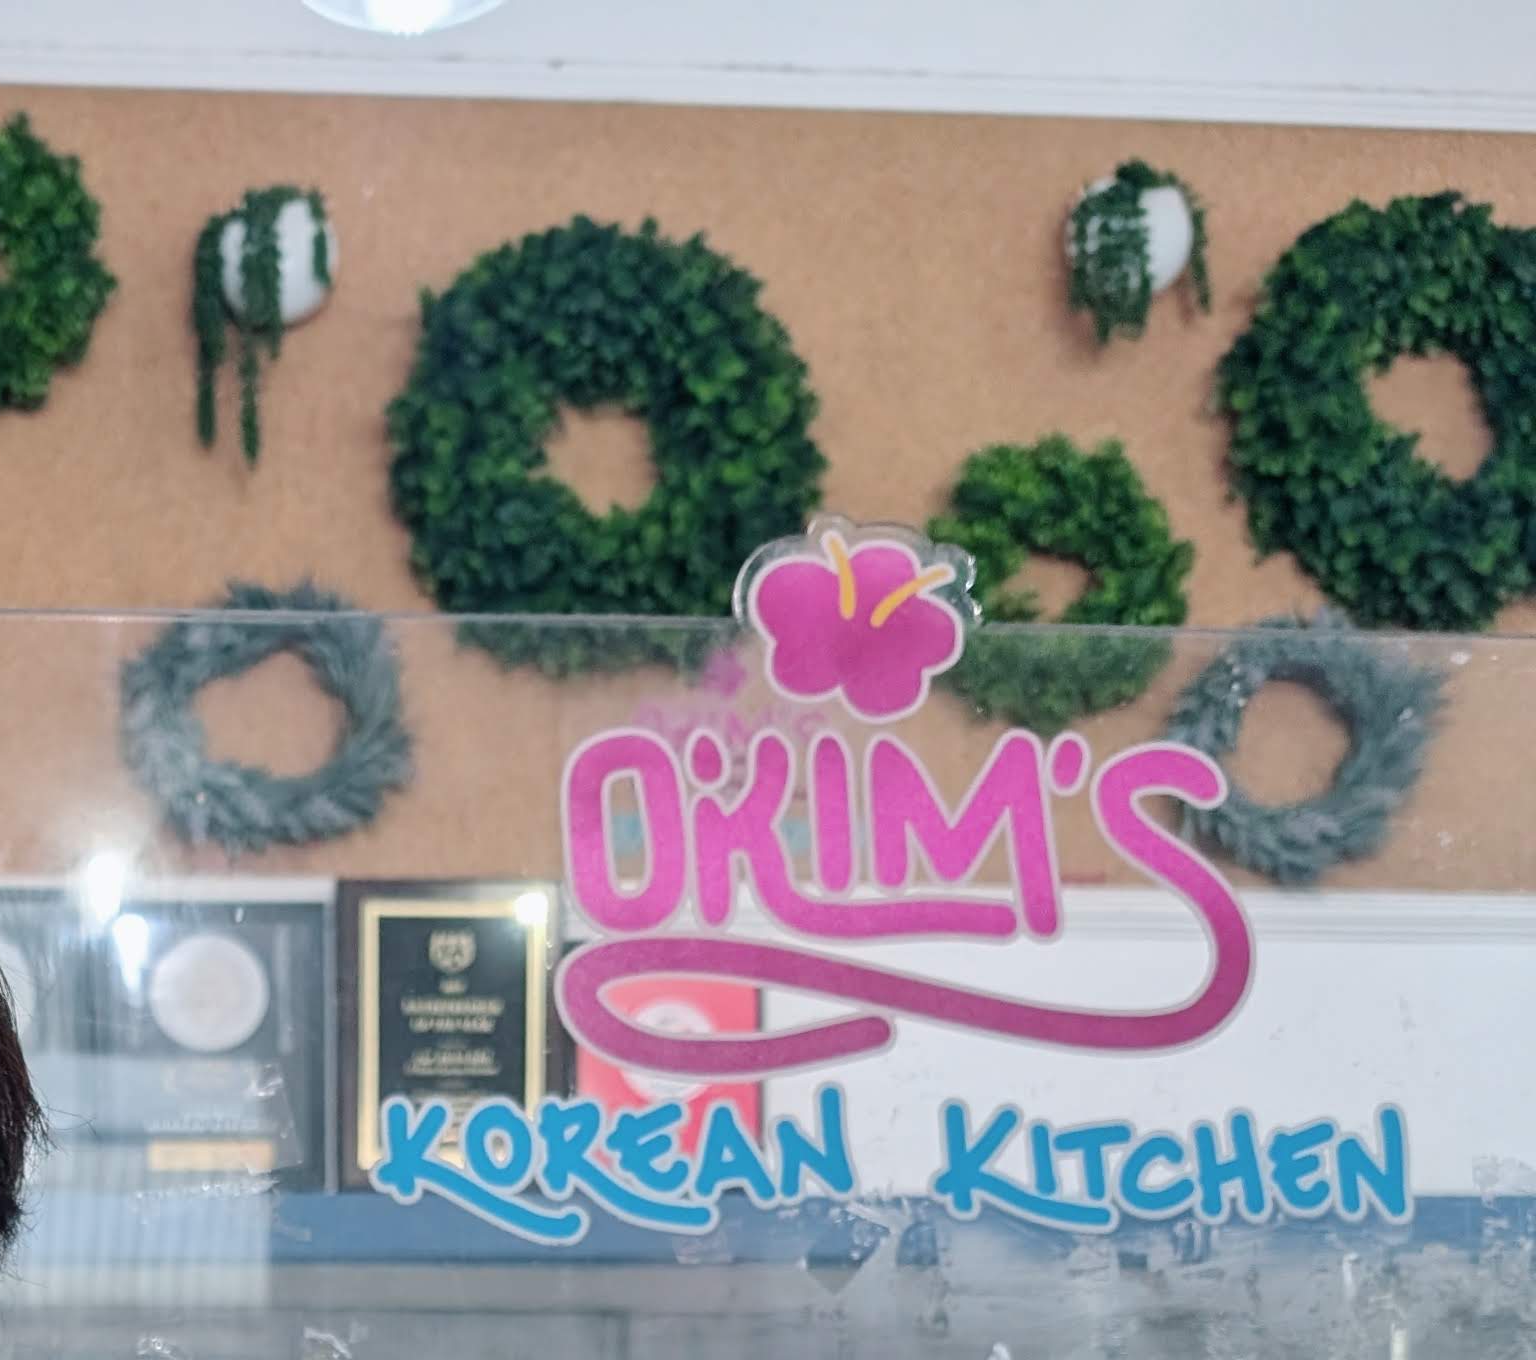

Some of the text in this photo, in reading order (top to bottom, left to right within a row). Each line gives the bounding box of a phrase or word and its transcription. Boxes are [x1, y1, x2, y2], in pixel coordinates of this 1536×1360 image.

[556, 727, 1254, 1077] O'KIM'S
[373, 1081, 1413, 1244] KOREAN KITCHEN
